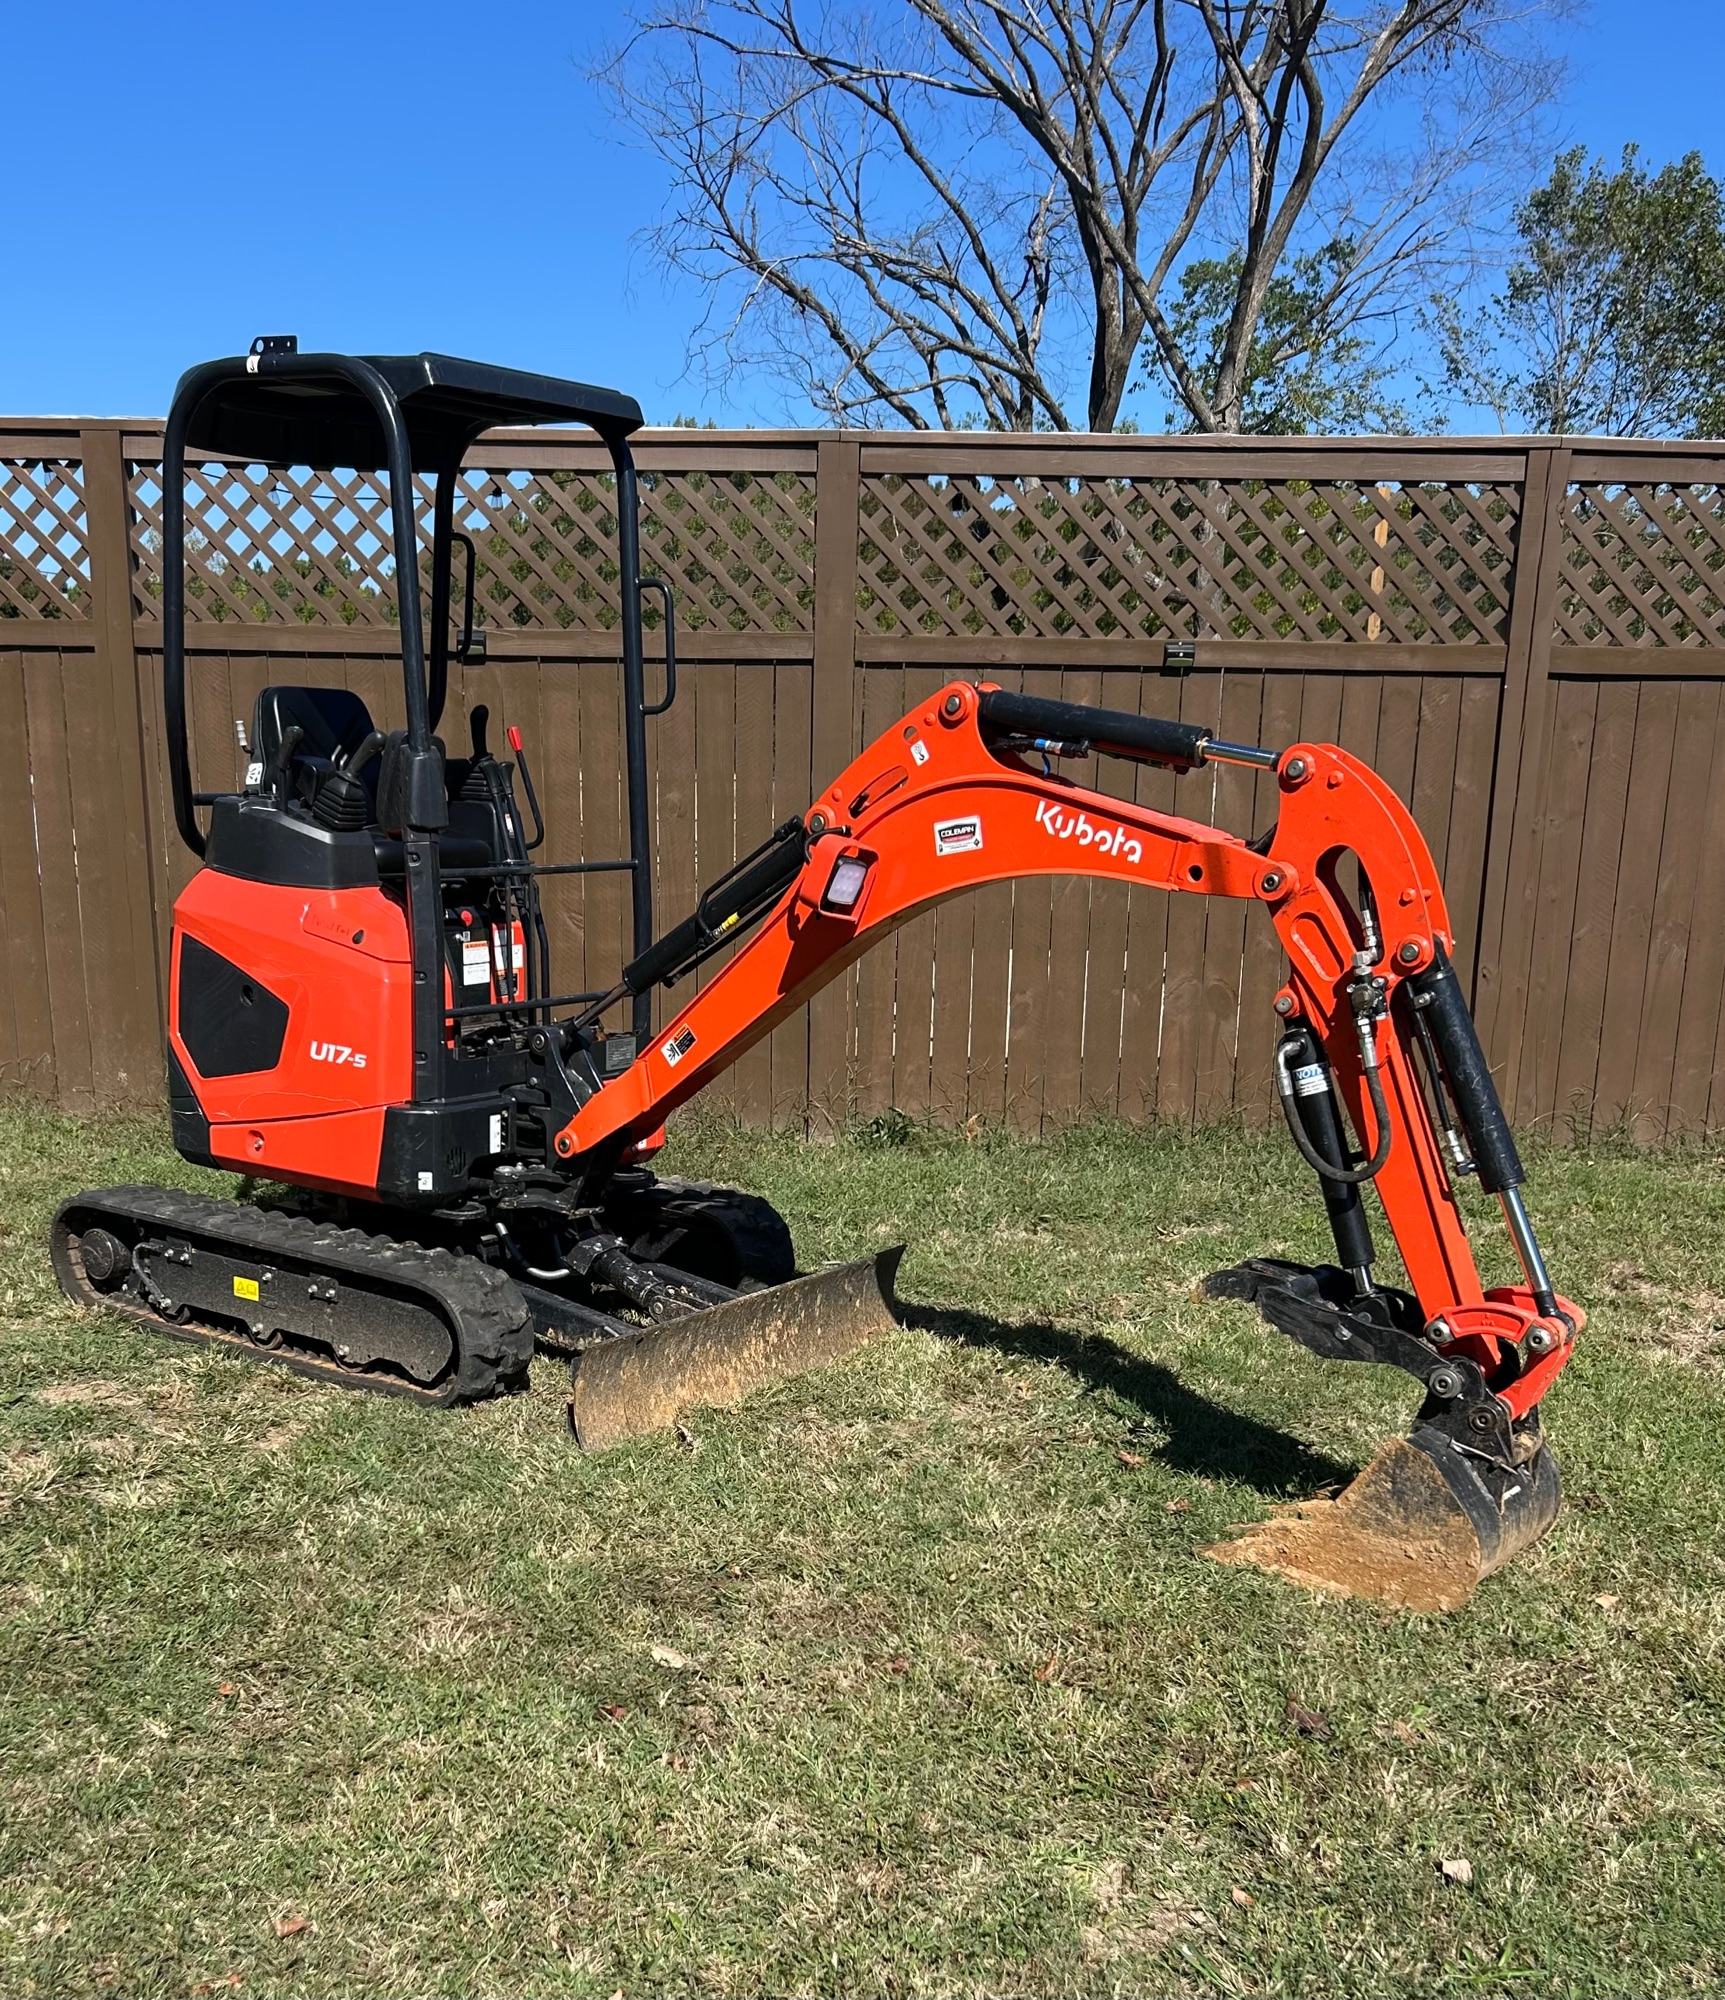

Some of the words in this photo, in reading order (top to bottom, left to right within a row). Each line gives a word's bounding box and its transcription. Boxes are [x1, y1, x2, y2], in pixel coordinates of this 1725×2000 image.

[940, 825, 975, 838] COLEMAN
[1035, 800, 1142, 864] Kubota
[310, 1040, 367, 1068] U17-5
